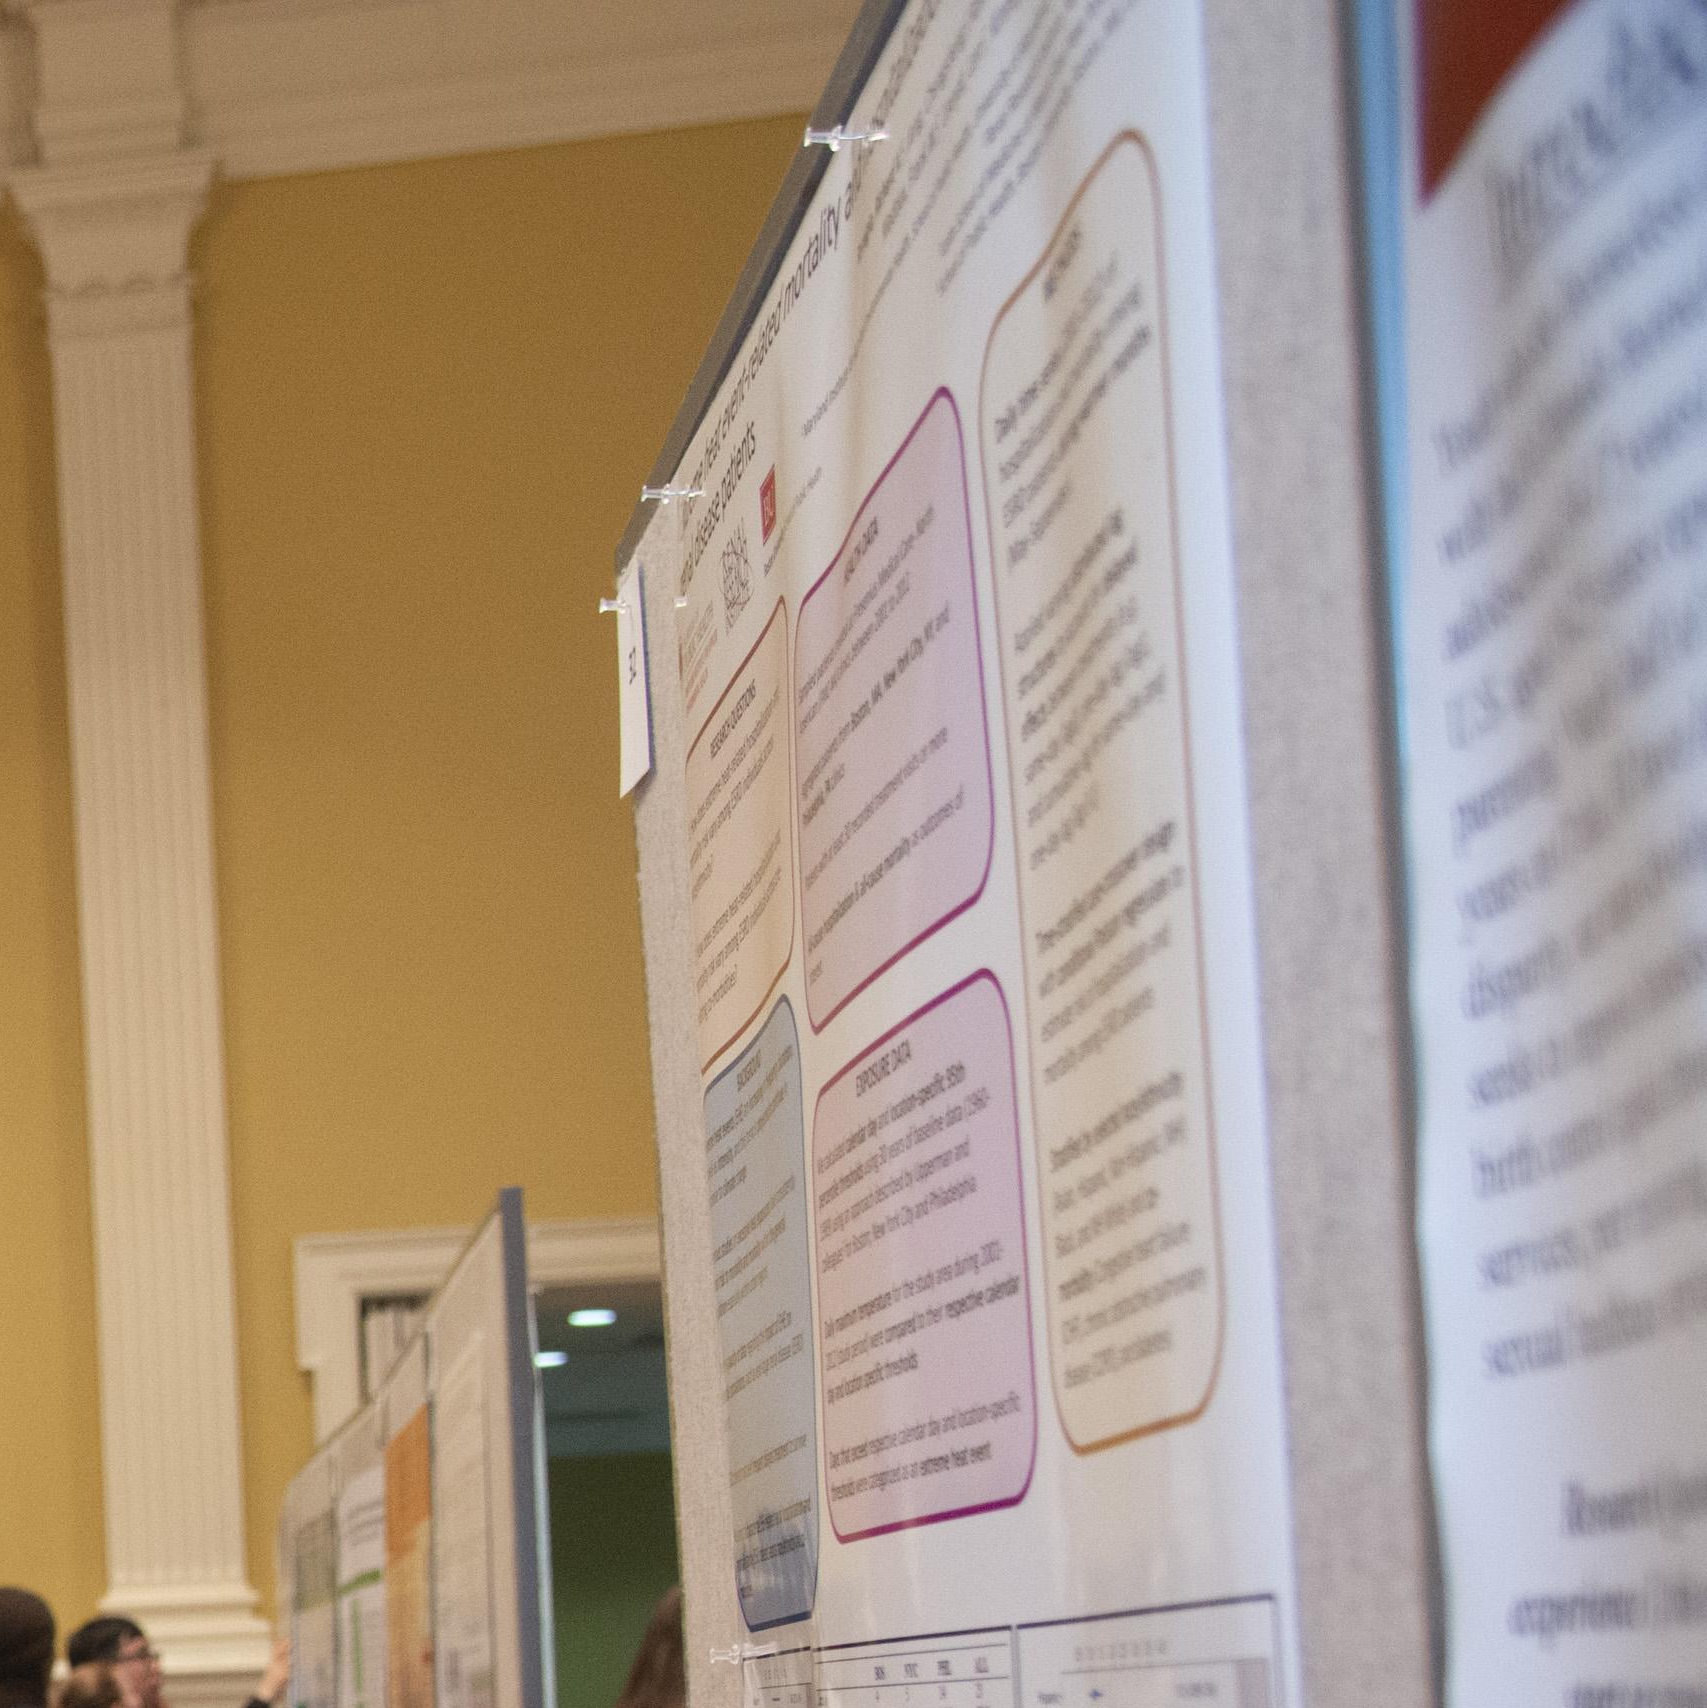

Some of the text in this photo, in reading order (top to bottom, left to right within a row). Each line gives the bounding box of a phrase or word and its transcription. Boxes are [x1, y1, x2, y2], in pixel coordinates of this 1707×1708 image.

[783, 197, 840, 320] mortality
[695, 488, 719, 562] disease
[721, 415, 755, 517] patients
[890, 1073, 944, 1118] location-specific
